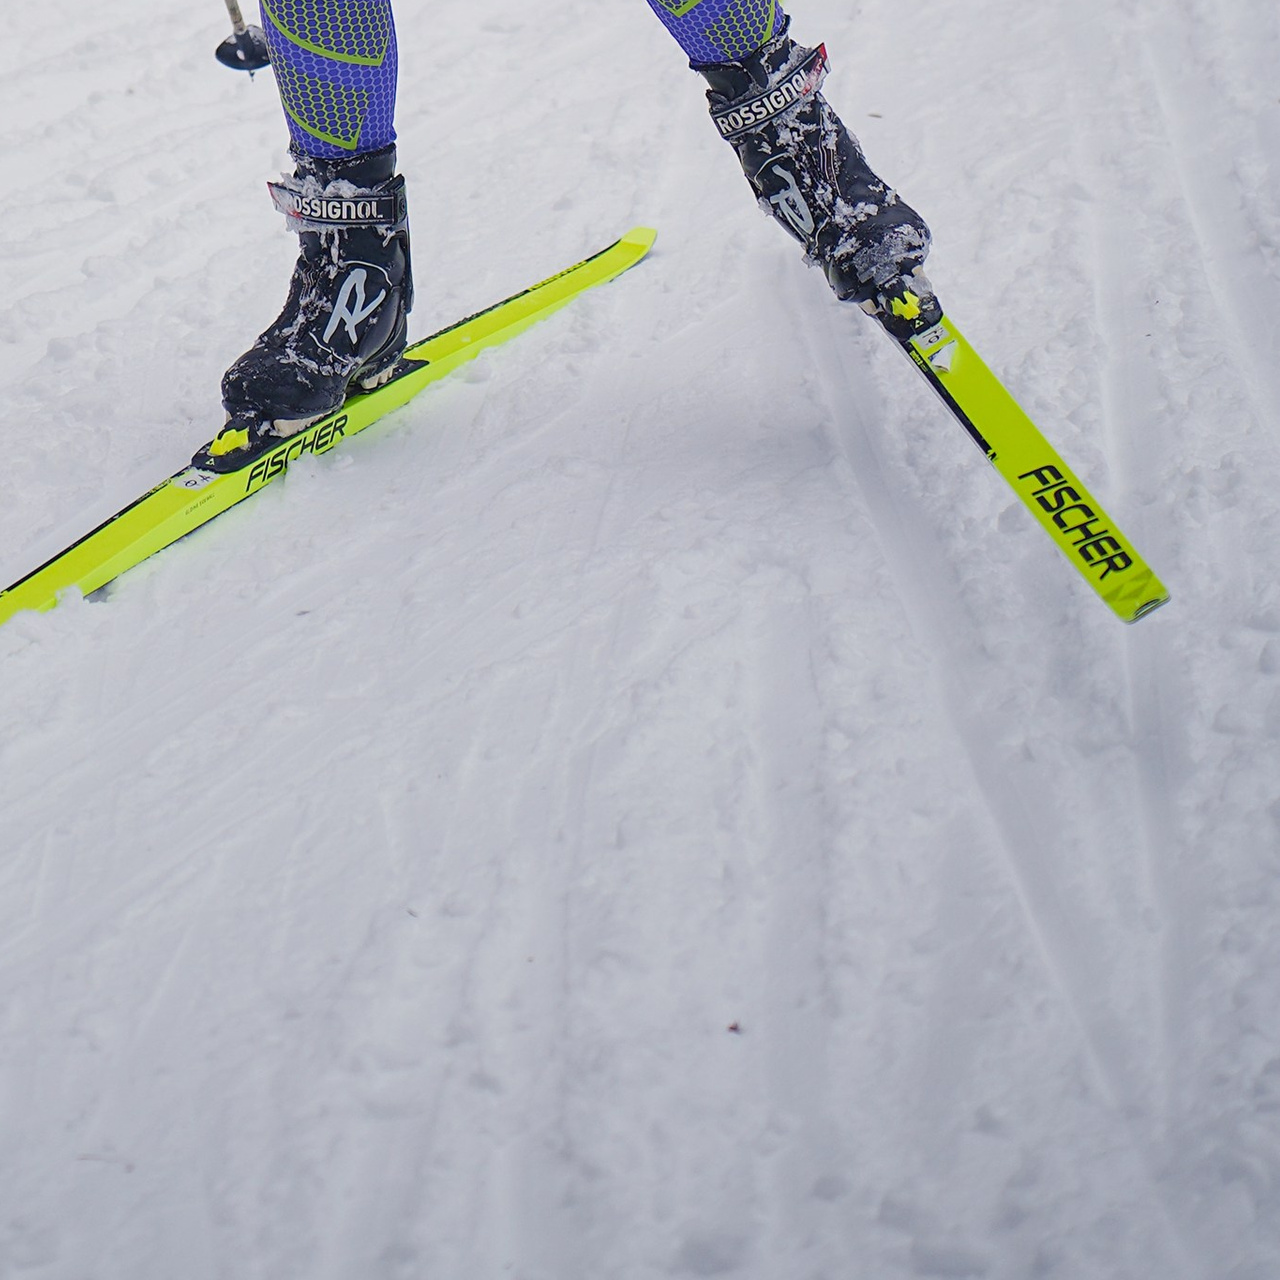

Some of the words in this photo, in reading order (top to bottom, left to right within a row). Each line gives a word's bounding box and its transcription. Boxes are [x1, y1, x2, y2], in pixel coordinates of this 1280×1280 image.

[293, 197, 384, 220] OSSIGNOL
[246, 414, 348, 492] FISCHER
[1017, 465, 1133, 580] FISCHER
